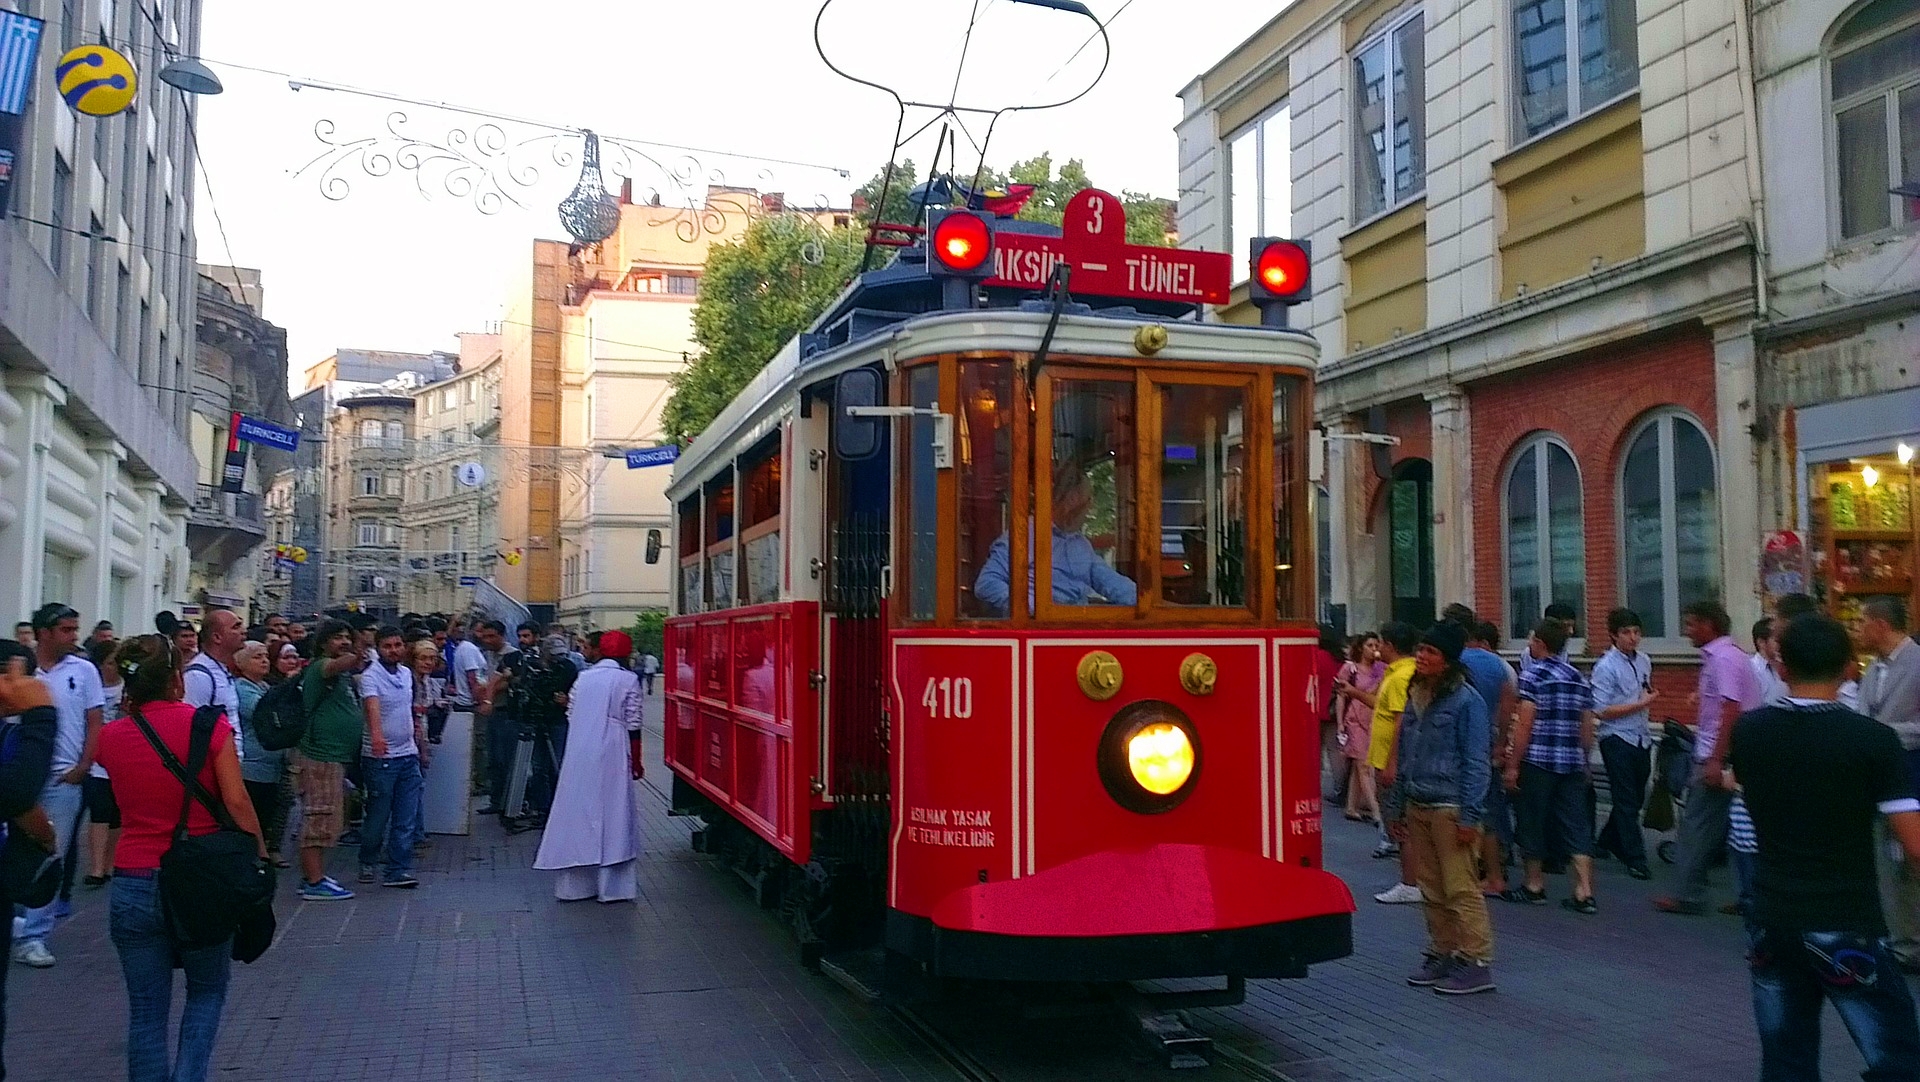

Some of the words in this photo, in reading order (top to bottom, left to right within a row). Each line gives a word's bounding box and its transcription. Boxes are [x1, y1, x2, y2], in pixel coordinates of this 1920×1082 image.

[1086, 195, 1104, 235] 3
[994, 245, 1065, 286] AKSİM
[1125, 254, 1204, 296] TÜNEL
[922, 676, 972, 719] 410
[1305, 674, 1320, 714] 41
[952, 808, 992, 827] YASAK
